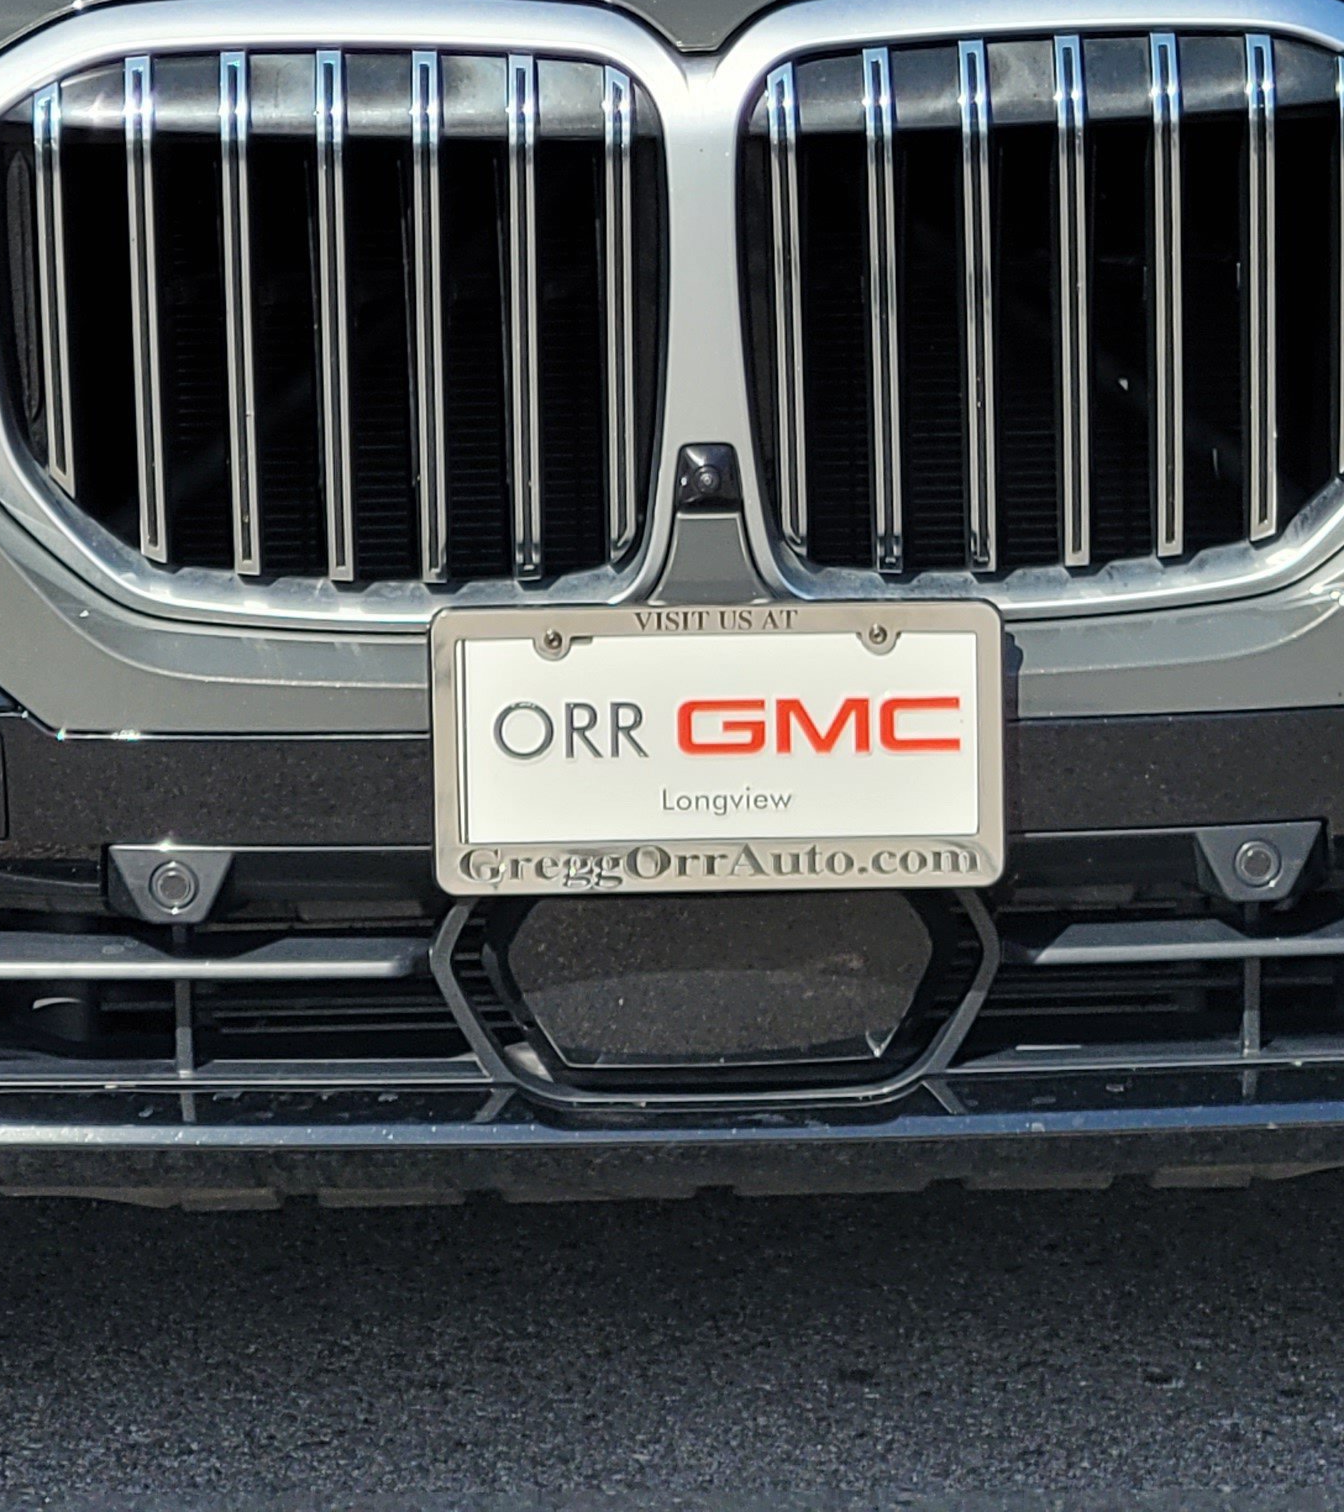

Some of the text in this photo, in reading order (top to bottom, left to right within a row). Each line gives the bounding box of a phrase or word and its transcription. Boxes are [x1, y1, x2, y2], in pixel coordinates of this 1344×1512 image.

[634, 609, 798, 631] VISIT US AT
[493, 696, 961, 759] ORR GMC
[661, 787, 793, 816] Longview
[459, 844, 981, 888] GreggOrrAuto.com
